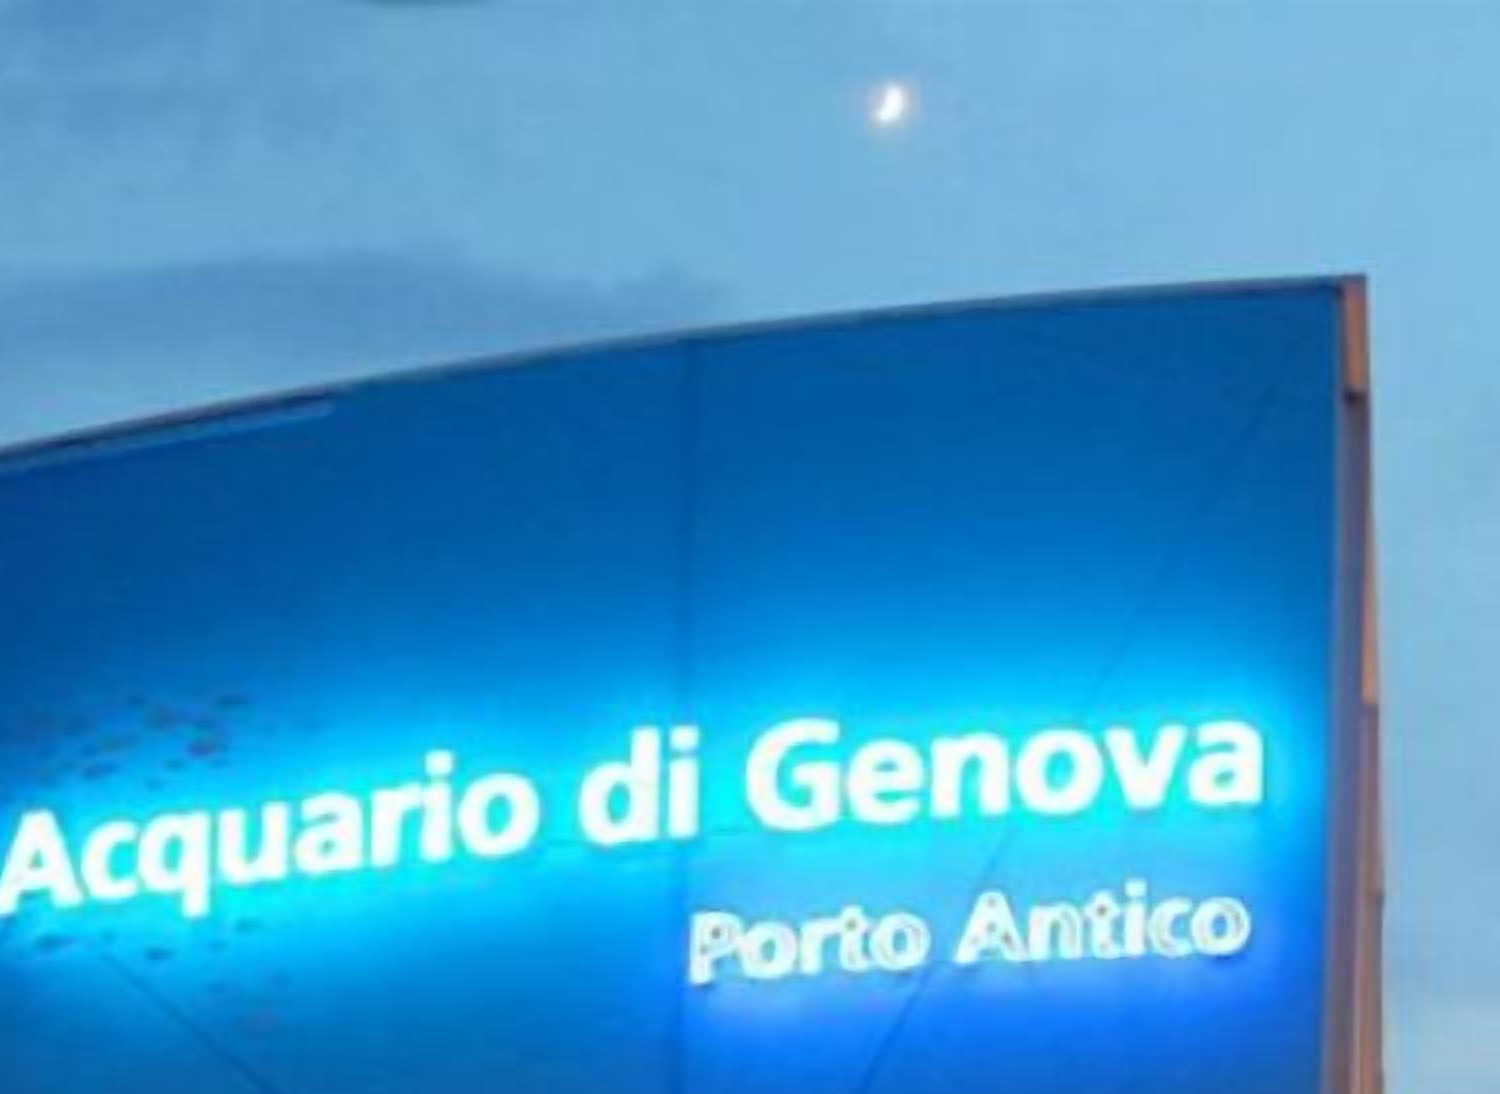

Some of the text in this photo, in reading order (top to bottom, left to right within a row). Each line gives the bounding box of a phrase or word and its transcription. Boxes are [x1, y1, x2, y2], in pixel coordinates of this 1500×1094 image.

[579, 727, 698, 845] di
[745, 719, 1264, 830] Genova
[690, 881, 1250, 984] Porto Antico
